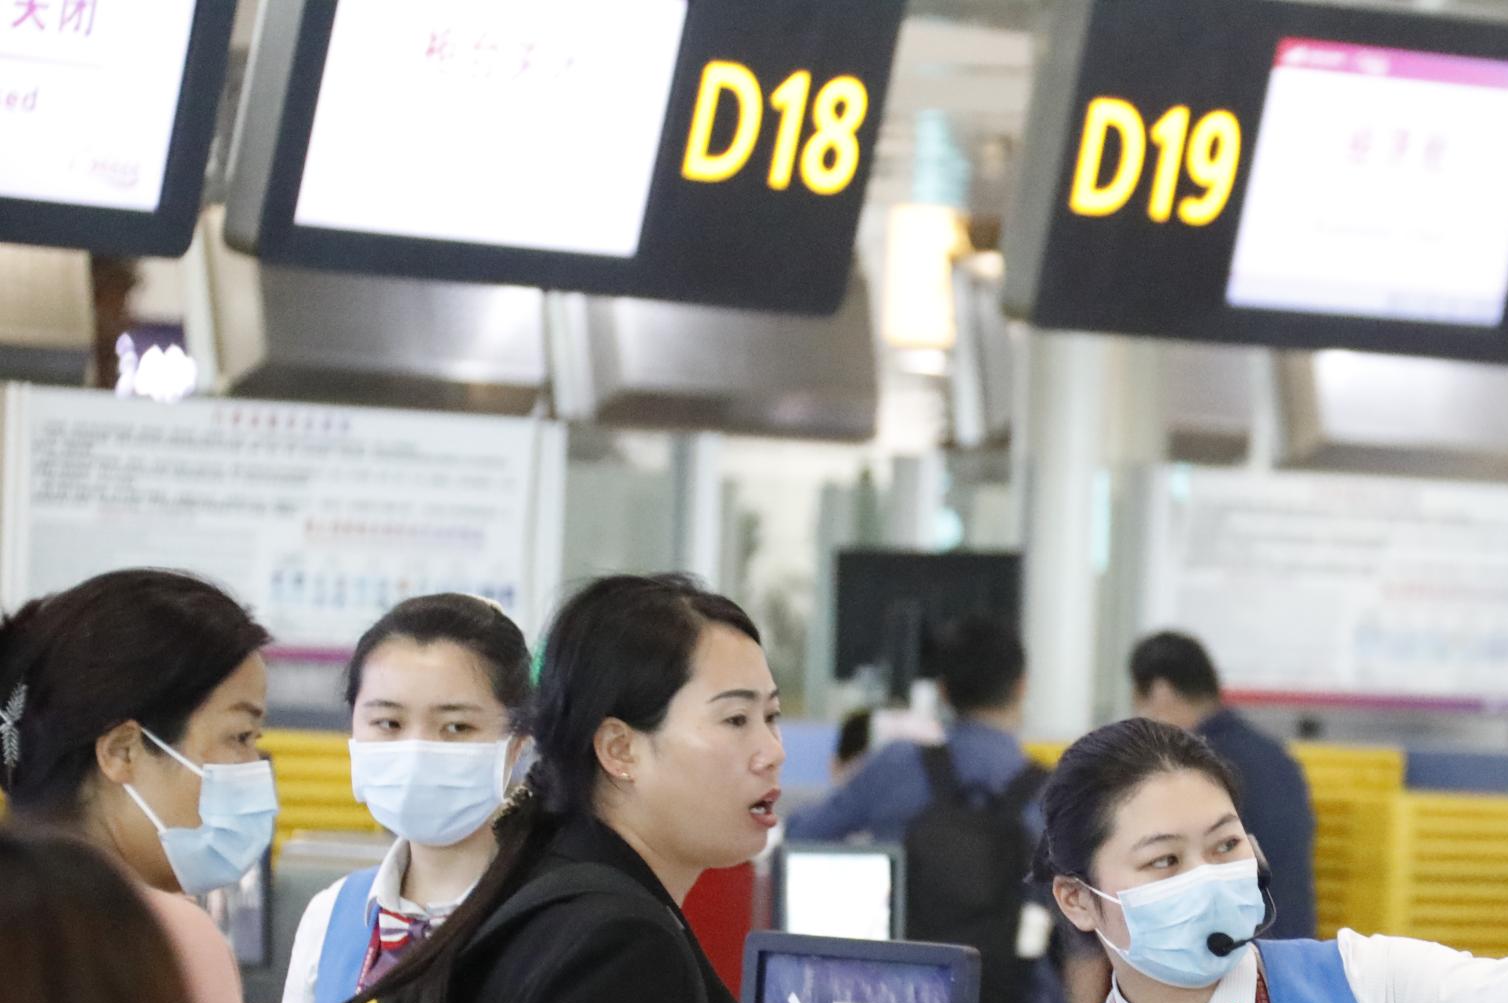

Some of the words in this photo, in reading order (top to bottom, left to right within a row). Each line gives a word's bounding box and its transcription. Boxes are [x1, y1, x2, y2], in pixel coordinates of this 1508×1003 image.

[0, 88, 40, 112] ed
[681, 60, 869, 195] D18
[1069, 97, 1241, 226] D19
